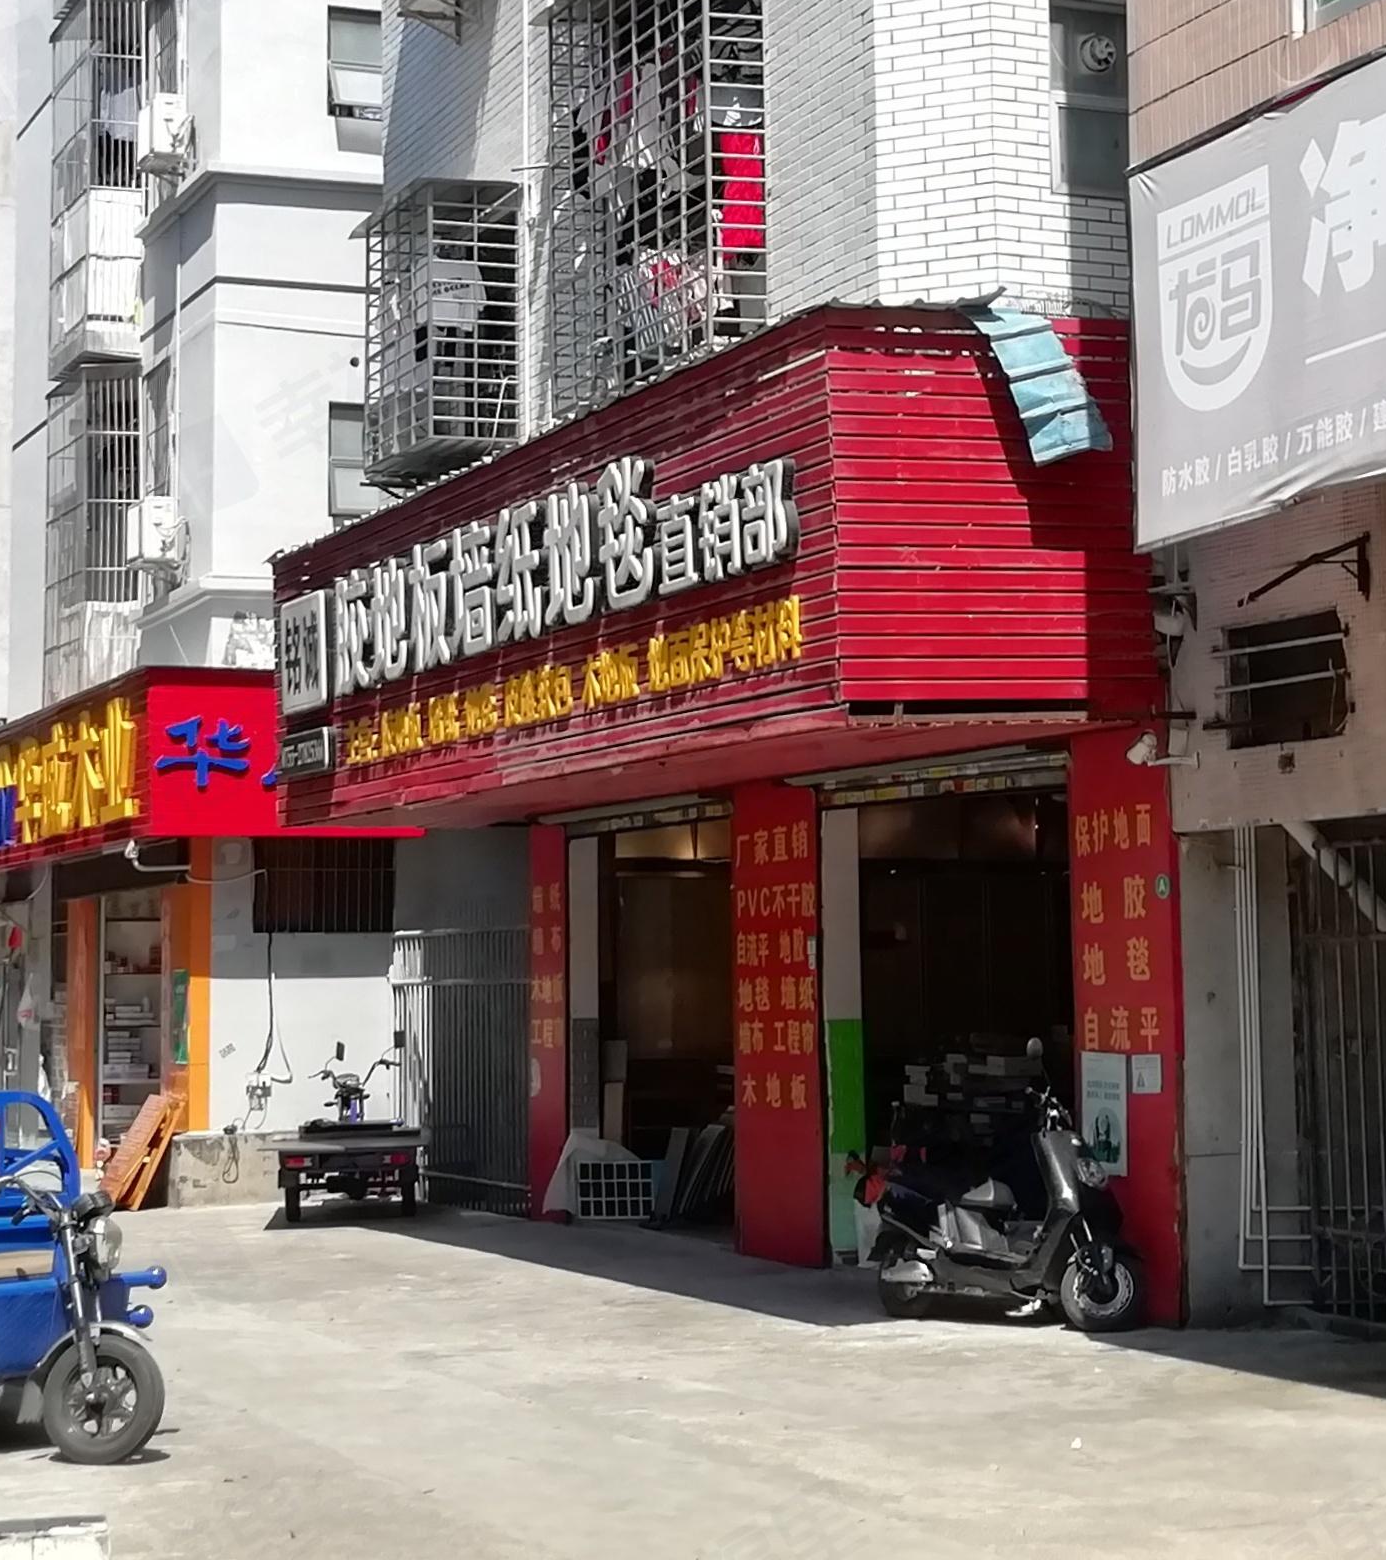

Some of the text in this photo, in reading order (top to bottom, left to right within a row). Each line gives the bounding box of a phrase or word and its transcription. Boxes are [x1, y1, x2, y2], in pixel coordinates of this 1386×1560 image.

[1166, 186, 1267, 250] LOMMOL
[734, 819, 810, 869] 厂家直销
[1074, 802, 1153, 859] 保护地面
[736, 929, 770, 968] 自流平
[738, 974, 816, 1013] 地毯 墙纸
[1083, 1004, 1161, 1052] 自流平
[741, 1071, 808, 1111] 木地板
